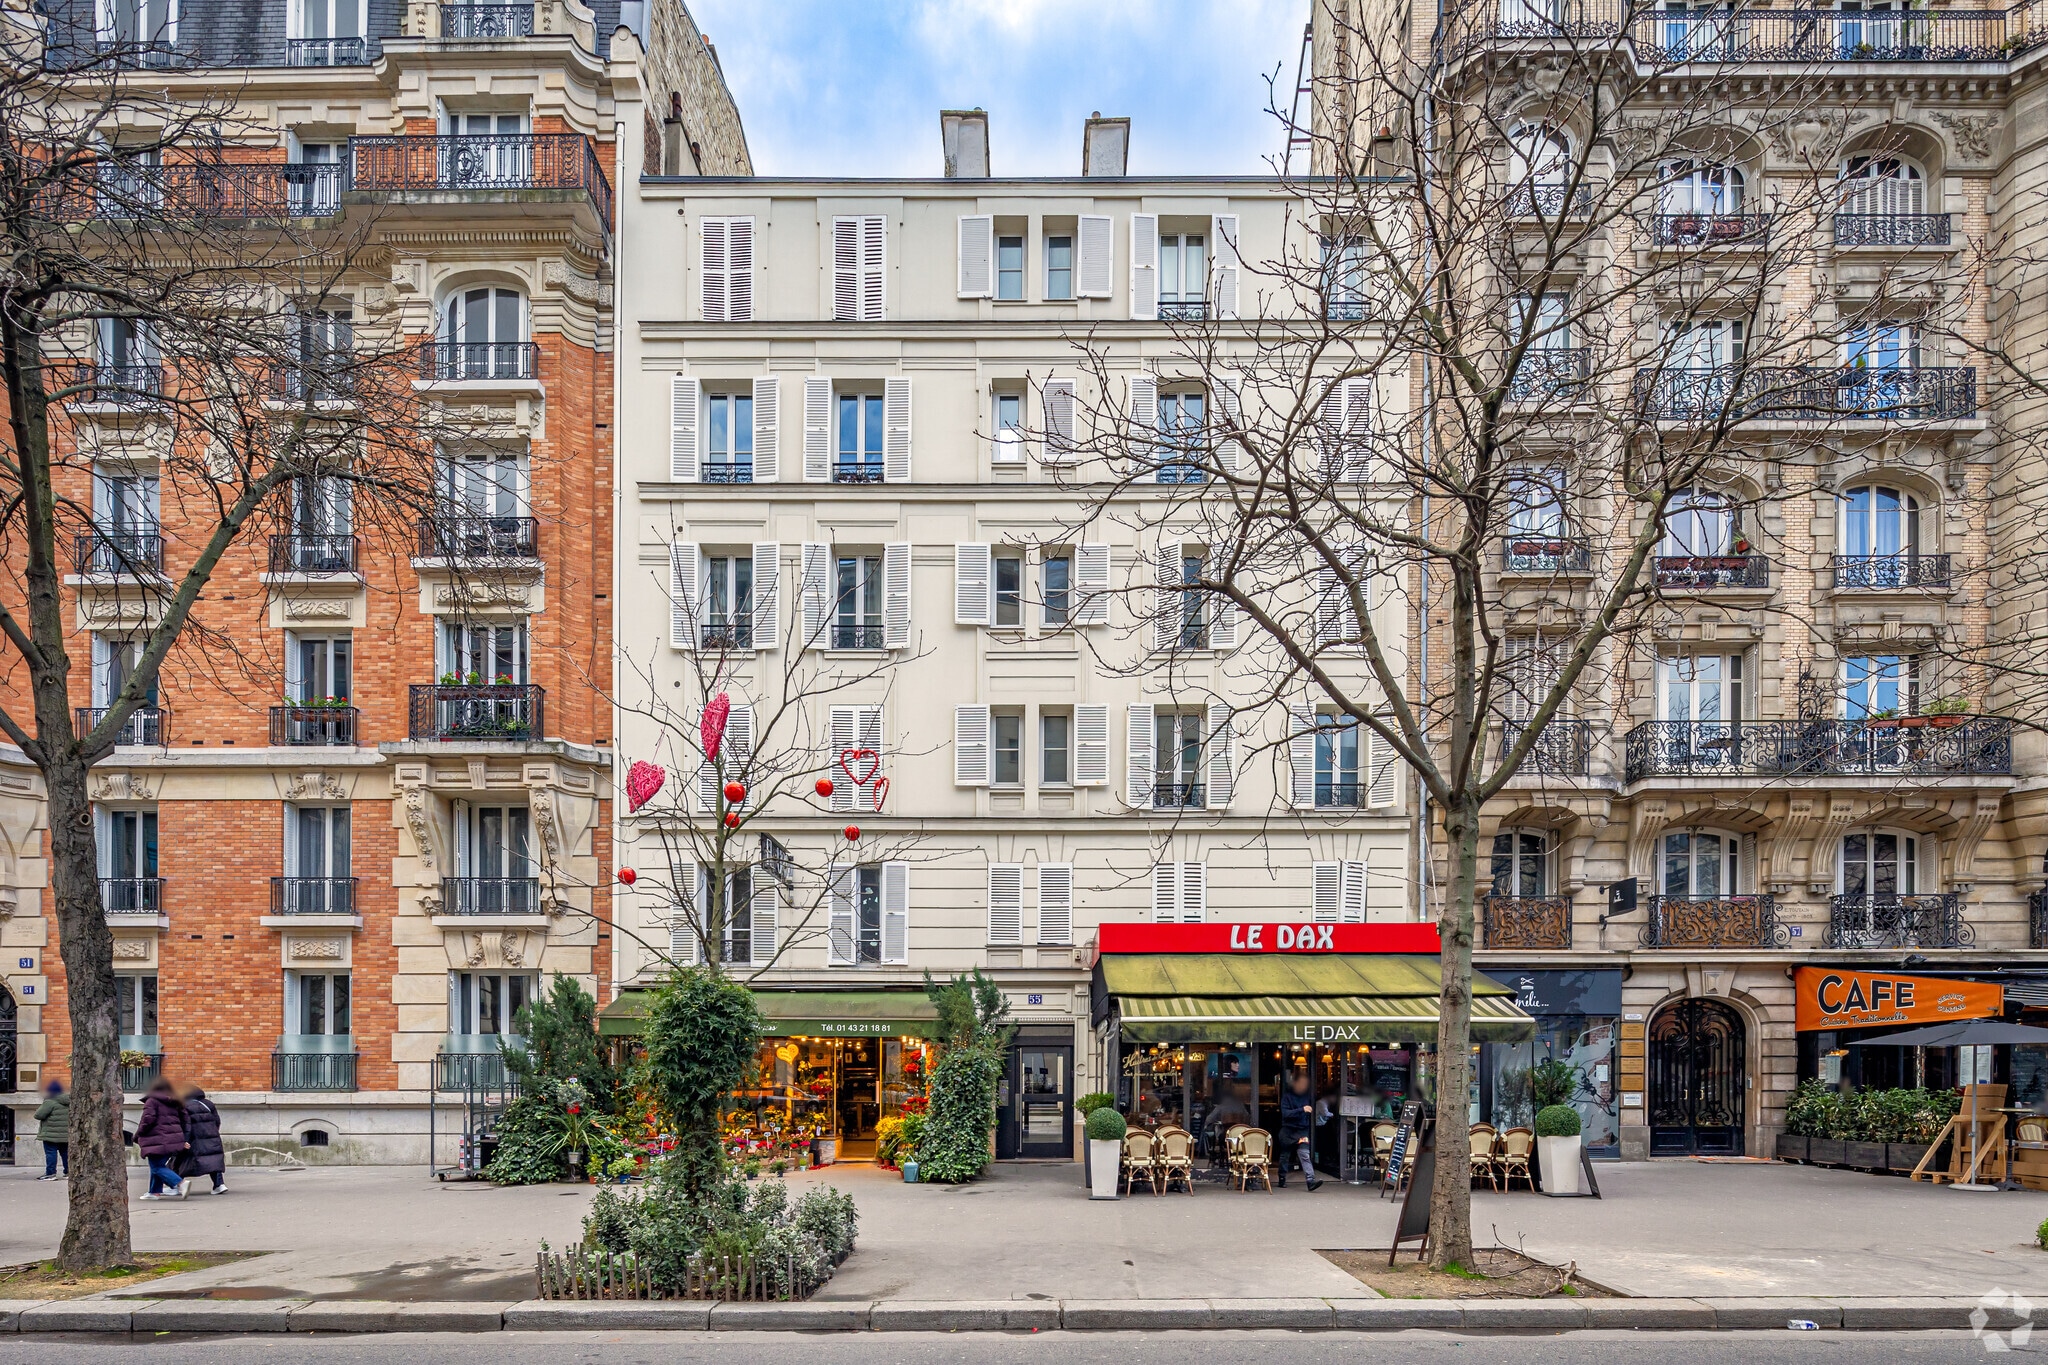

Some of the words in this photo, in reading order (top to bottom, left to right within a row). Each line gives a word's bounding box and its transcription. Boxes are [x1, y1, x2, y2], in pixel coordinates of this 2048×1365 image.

[1230, 925, 1264, 949] LE
[1277, 925, 1334, 949] DAX
[1792, 927, 1801, 936] 57
[21, 959, 31, 967] 51
[1029, 995, 1041, 1004] 55
[1514, 990, 1550, 1008] mélie...
[1817, 974, 1915, 1015] CAFE
[1937, 993, 1966, 1004] SERVICE
[1820, 1016, 1849, 1027] Cuisine
[1851, 1011, 1908, 1026] Traditionnelle
[821, 1023, 835, 1032] Tél.
[836, 1024, 846, 1032] 01
[848, 1024, 858, 1032] 43
[859, 1024, 868, 1032] 21
[871, 1024, 880, 1032] 18
[881, 1024, 891, 1032] 81
[1293, 1025, 1316, 1040] LE
[1321, 1025, 1361, 1040] DAX
